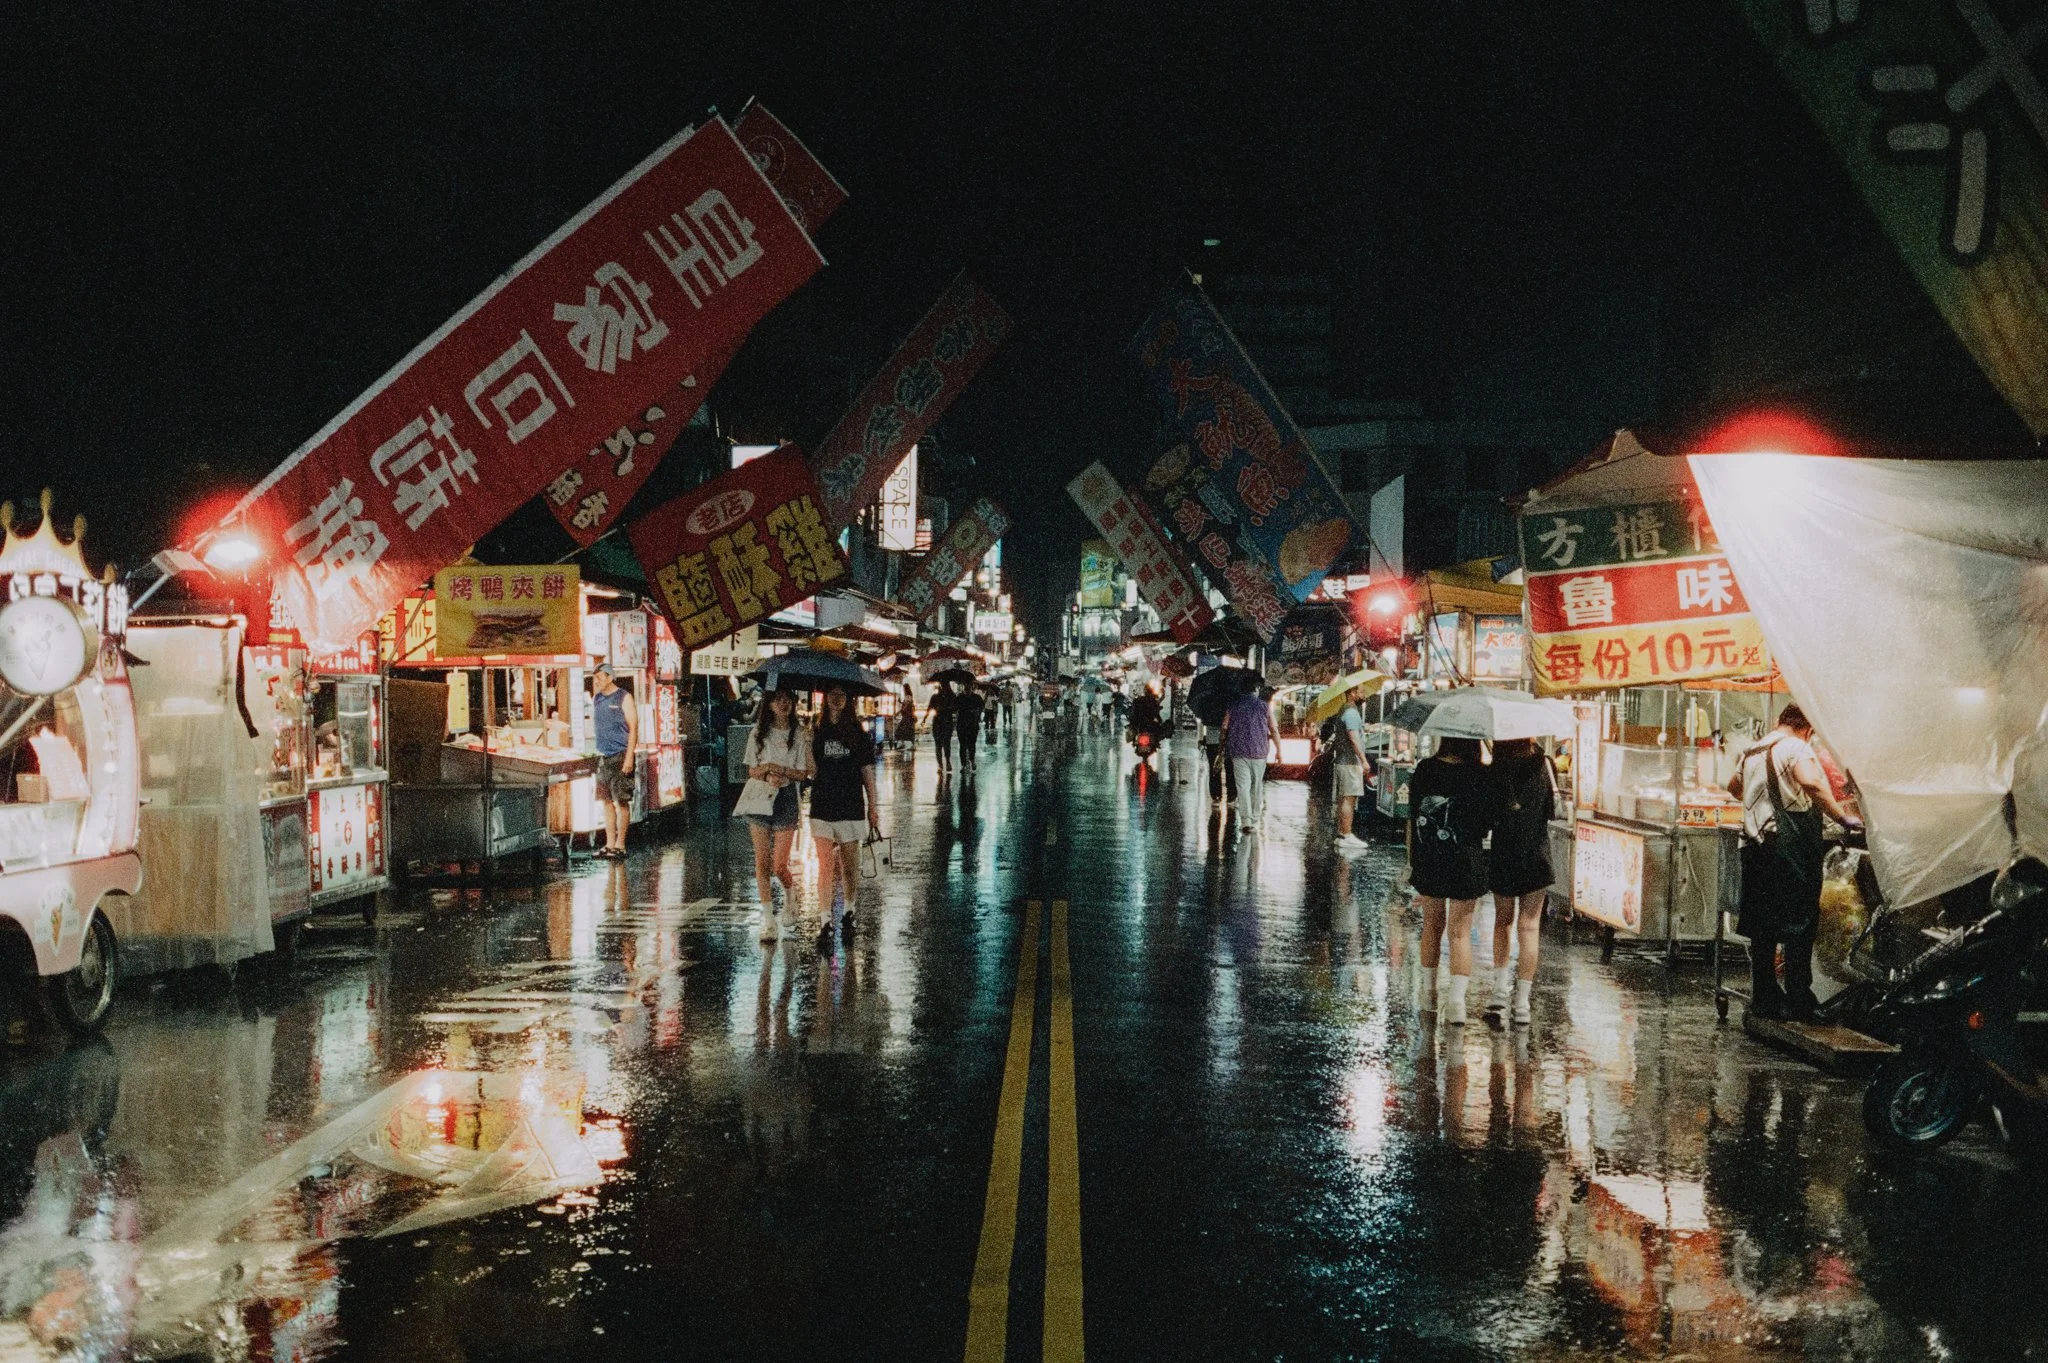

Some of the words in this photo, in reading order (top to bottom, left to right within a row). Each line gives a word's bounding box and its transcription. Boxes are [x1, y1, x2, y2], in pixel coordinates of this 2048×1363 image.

[697, 492, 747, 531] 老店
[892, 466, 909, 529] SPACE
[449, 573, 566, 601] 烤鴨夾餅
[655, 494, 846, 648] 鹽酥雞
[1559, 563, 1733, 626] 魯味
[1544, 629, 1765, 685] 每份10元起
